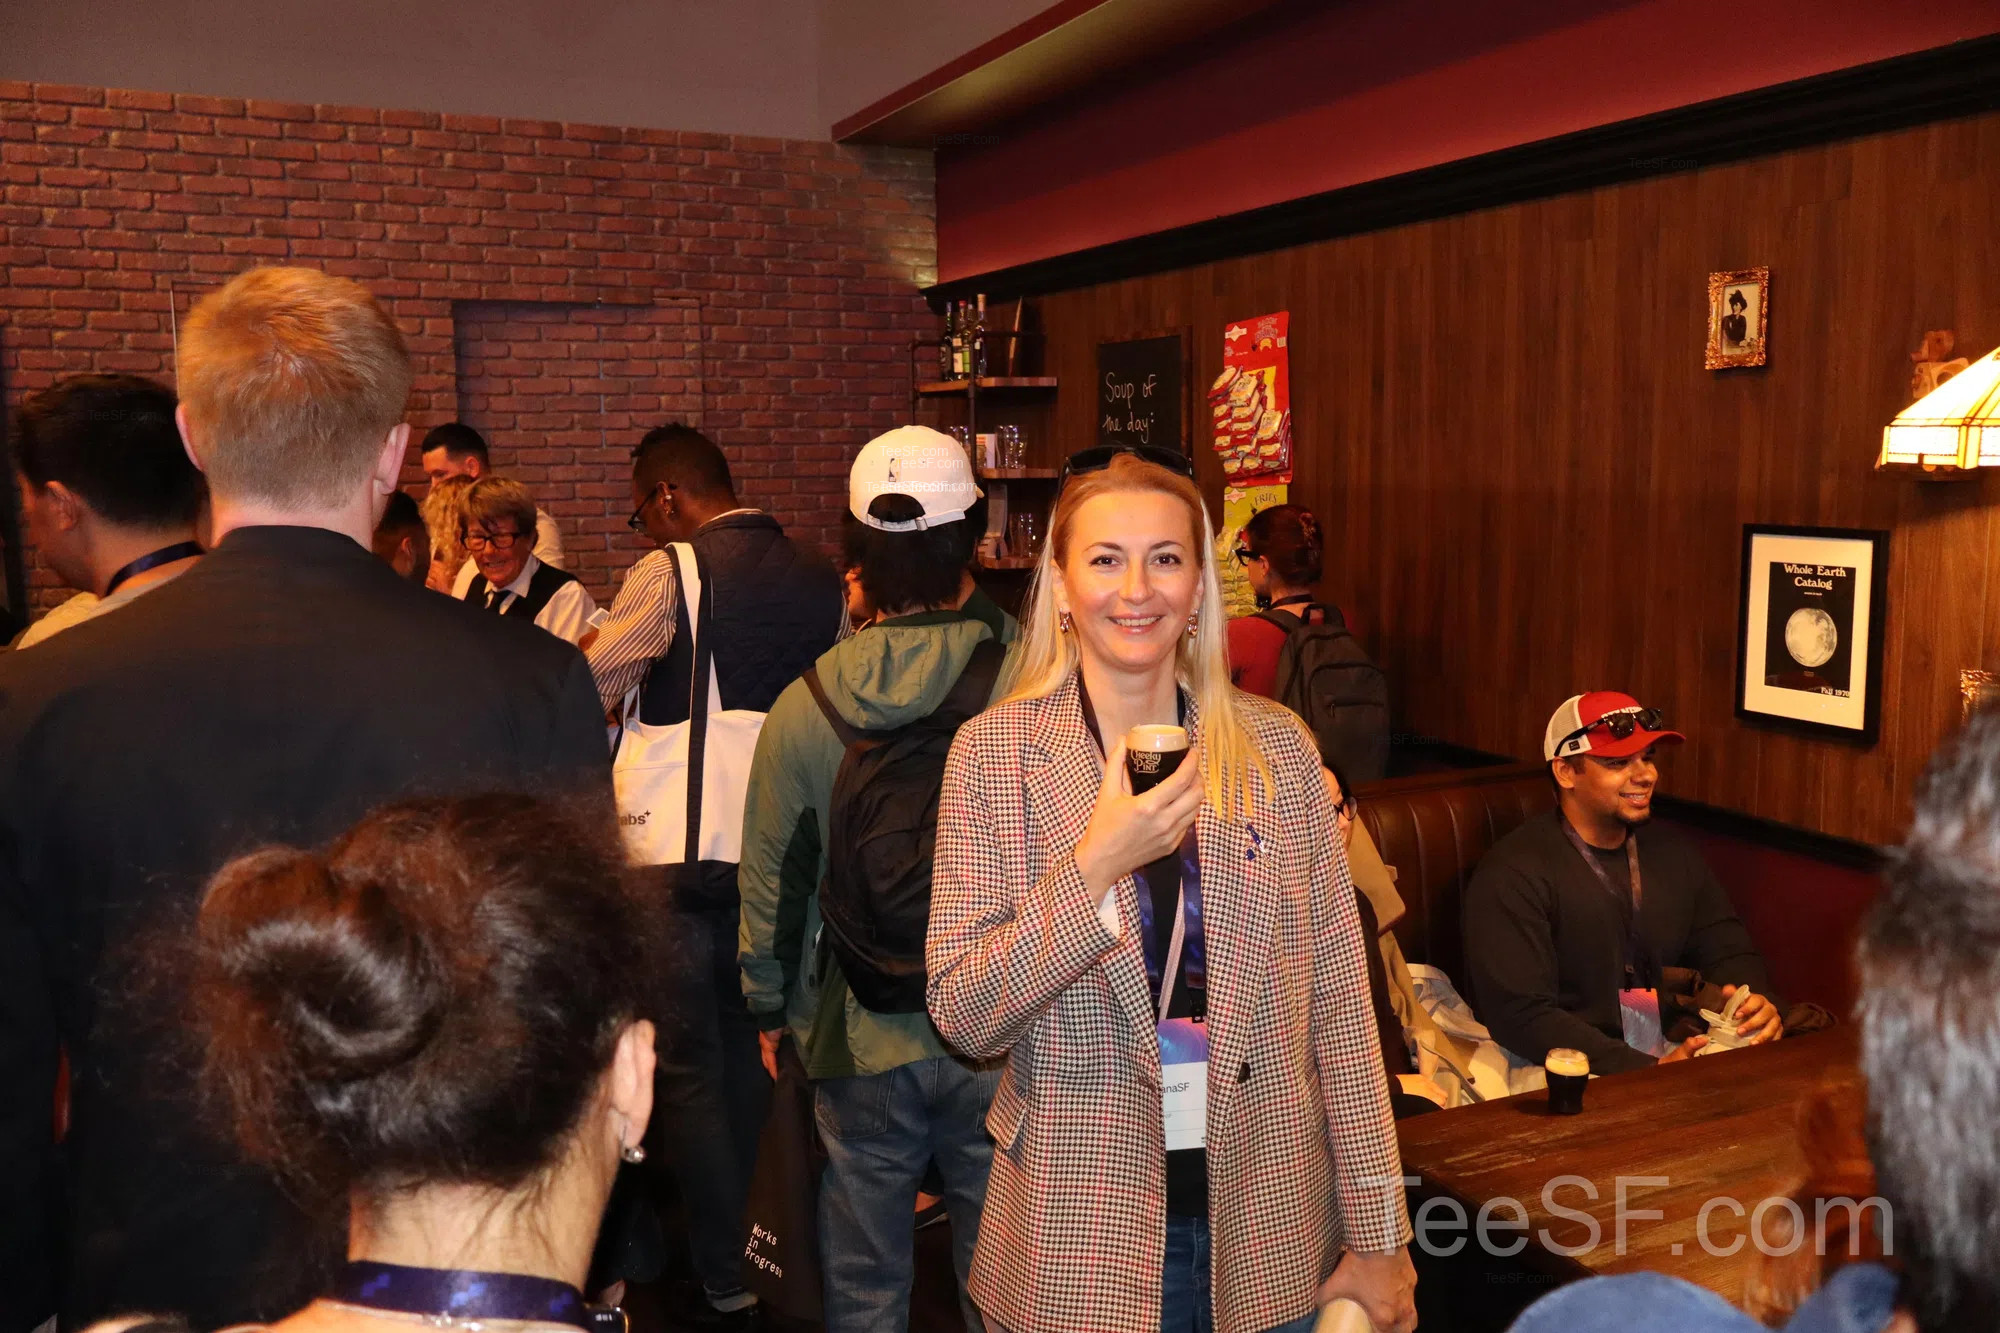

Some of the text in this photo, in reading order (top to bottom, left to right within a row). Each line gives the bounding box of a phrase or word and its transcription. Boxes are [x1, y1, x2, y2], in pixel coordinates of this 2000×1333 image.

[1105, 371, 1157, 409] Soup of
[1102, 411, 1154, 444] the day:
[1783, 563, 1847, 577] Whole Earth
[1794, 577, 1833, 590] Catalog
[1820, 687, 1850, 698] Fall 1970
[752, 1222, 777, 1246] Works
[748, 1235, 759, 1249] in
